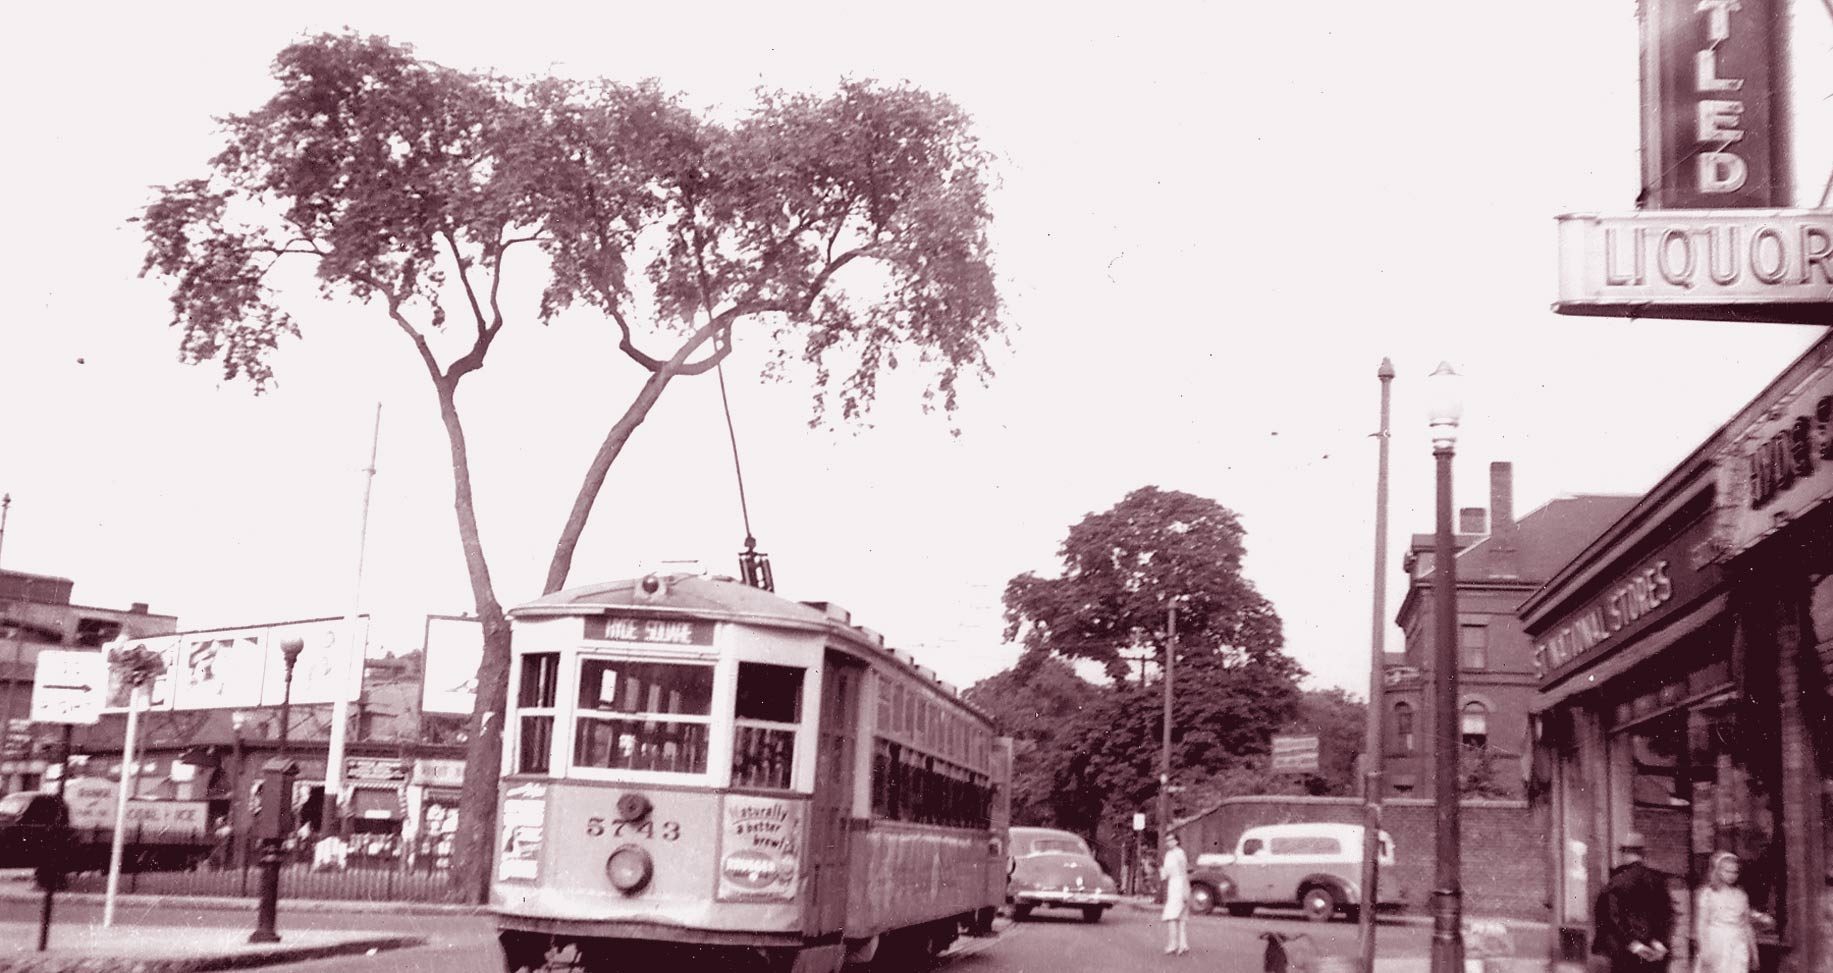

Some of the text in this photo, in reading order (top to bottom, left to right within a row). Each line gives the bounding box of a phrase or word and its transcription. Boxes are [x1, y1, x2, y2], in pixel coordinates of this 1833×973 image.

[1605, 225, 1833, 290] LIQUOR
[1609, 560, 1673, 631] STORES
[643, 619, 693, 644] SQUARE
[729, 803, 788, 822] Naturally
[587, 817, 680, 841] 5743
[746, 821, 781, 834] better
